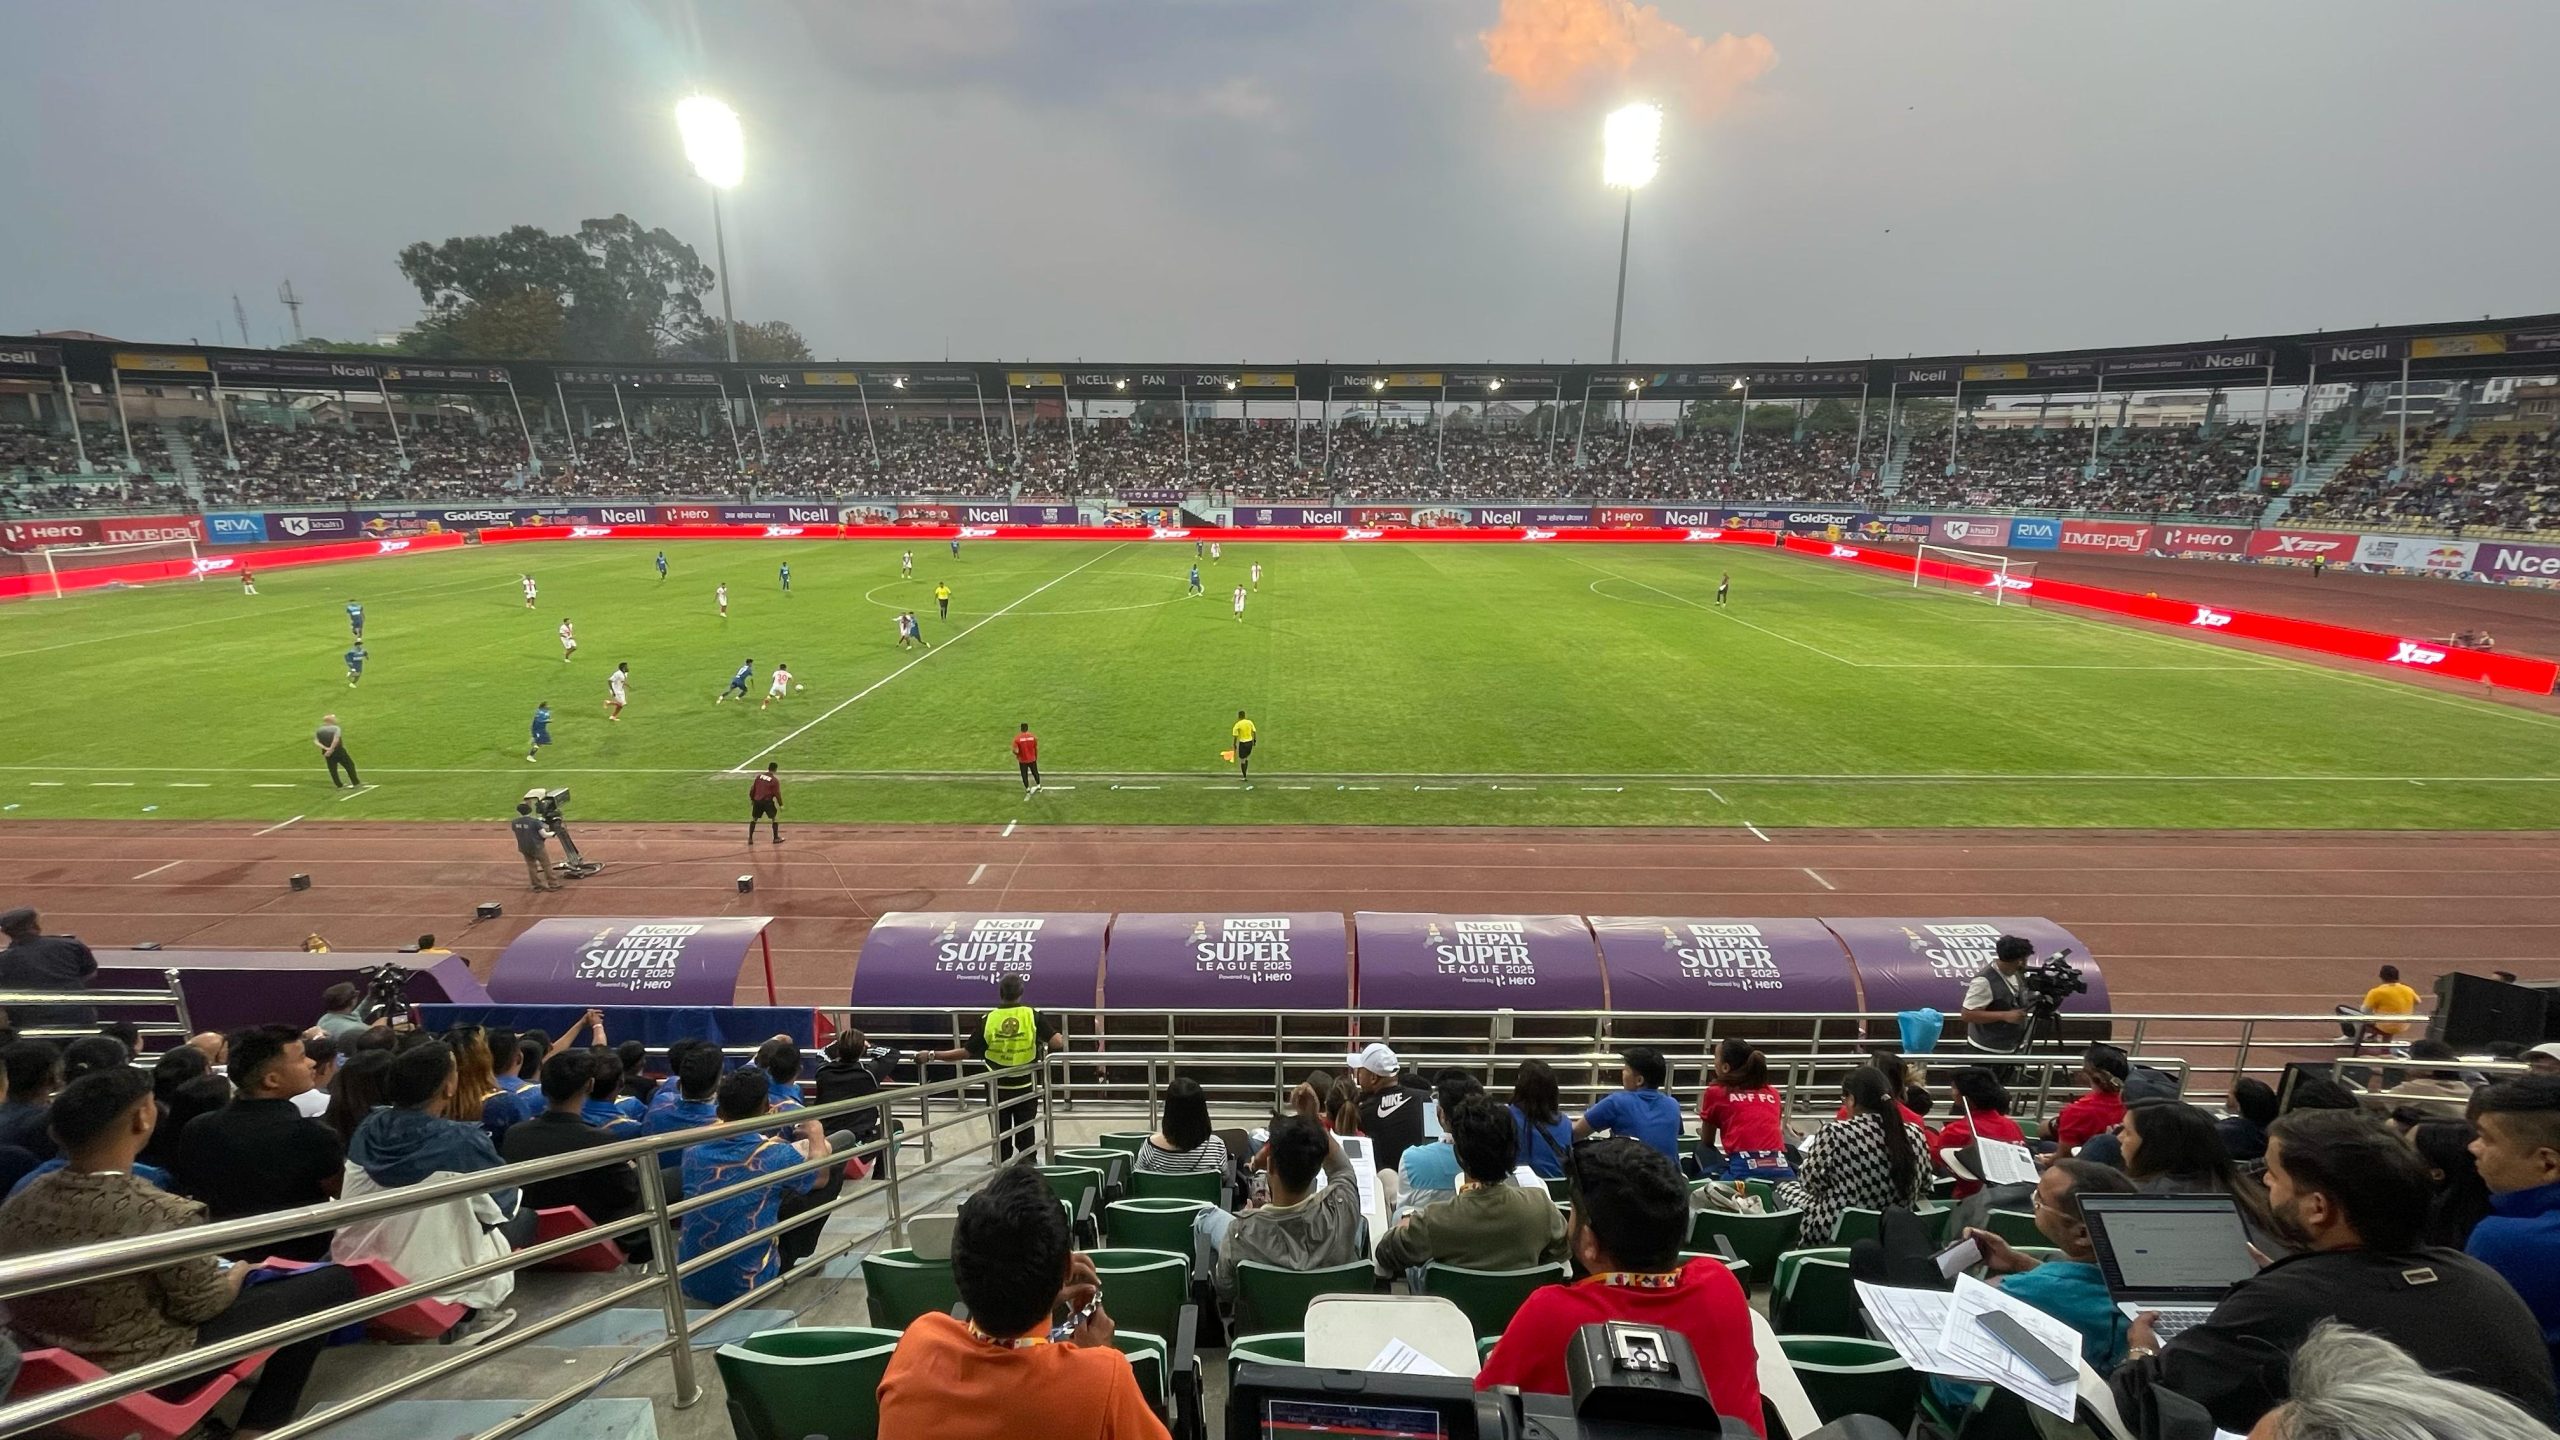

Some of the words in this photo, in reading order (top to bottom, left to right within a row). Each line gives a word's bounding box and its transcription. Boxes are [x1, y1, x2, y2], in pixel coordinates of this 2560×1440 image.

[2331, 344, 2387, 362] Ncell
[2205, 352, 2256, 368] Ncell
[331, 364, 375, 378] Ncell
[1909, 370, 1946, 382] Ncell
[760, 374, 790, 385] Ncell
[1076, 375, 1114, 386] NCELL
[1142, 375, 1165, 386] FAN
[1197, 375, 1230, 386] ZONE
[1344, 376, 1373, 386] Ncell
[444, 510, 512, 522] GoldStar
[601, 508, 646, 524] Ncell
[788, 508, 828, 522] Ncell
[968, 508, 1008, 522] Ncell
[1302, 510, 1342, 524] Ncell
[1482, 510, 1520, 524] Ncell
[1666, 512, 1708, 526] Ncell
[1789, 512, 1853, 524] GoldStar
[214, 518, 258, 533] RIVA
[2018, 524, 2053, 537] RIVA
[2267, 536, 2341, 552] XTEP
[2494, 548, 2560, 574] Nce
[2190, 608, 2232, 627] XTEP
[2388, 642, 2446, 664] XTEP
[636, 925, 692, 935] Ncell
[984, 920, 1035, 929] Ncell
[1232, 920, 1282, 928] Ncell
[1464, 922, 1514, 932] Ncell
[1698, 926, 1751, 935] Ncell
[1938, 926, 1992, 935] Ncell
[968, 930, 1036, 942] NEPAL
[1222, 930, 1290, 942] NEPAL
[1458, 934, 1528, 946] NEPAL
[1695, 936, 1769, 949] NEPAL
[616, 936, 686, 950] NEPAL
[1937, 936, 2001, 950] NEPA
[938, 942, 1033, 962] SUPER
[1196, 942, 1292, 962] SUPER
[1436, 946, 1534, 964] SUPER
[1677, 948, 1777, 969] SUPER
[580, 950, 680, 969] SUPER
[1926, 950, 1999, 969] SUPE
[936, 962, 996, 971] LEAGUE
[1003, 962, 1032, 971] 2025
[1196, 962, 1258, 971] LEAGUE
[1264, 962, 1292, 971] 2025
[1438, 964, 1500, 974] LEAGUE
[1506, 965, 1535, 974] 2025
[1682, 968, 1746, 978] LEAGUE
[1751, 968, 1780, 978] 2025
[1934, 968, 1981, 978] LEAG
[576, 969, 640, 979] LEAGUE
[646, 968, 676, 978] 2025
[1381, 1092, 1403, 1108] NIKE
[1729, 1093, 1755, 1102] APF
[1758, 1093, 1776, 1104] FC
